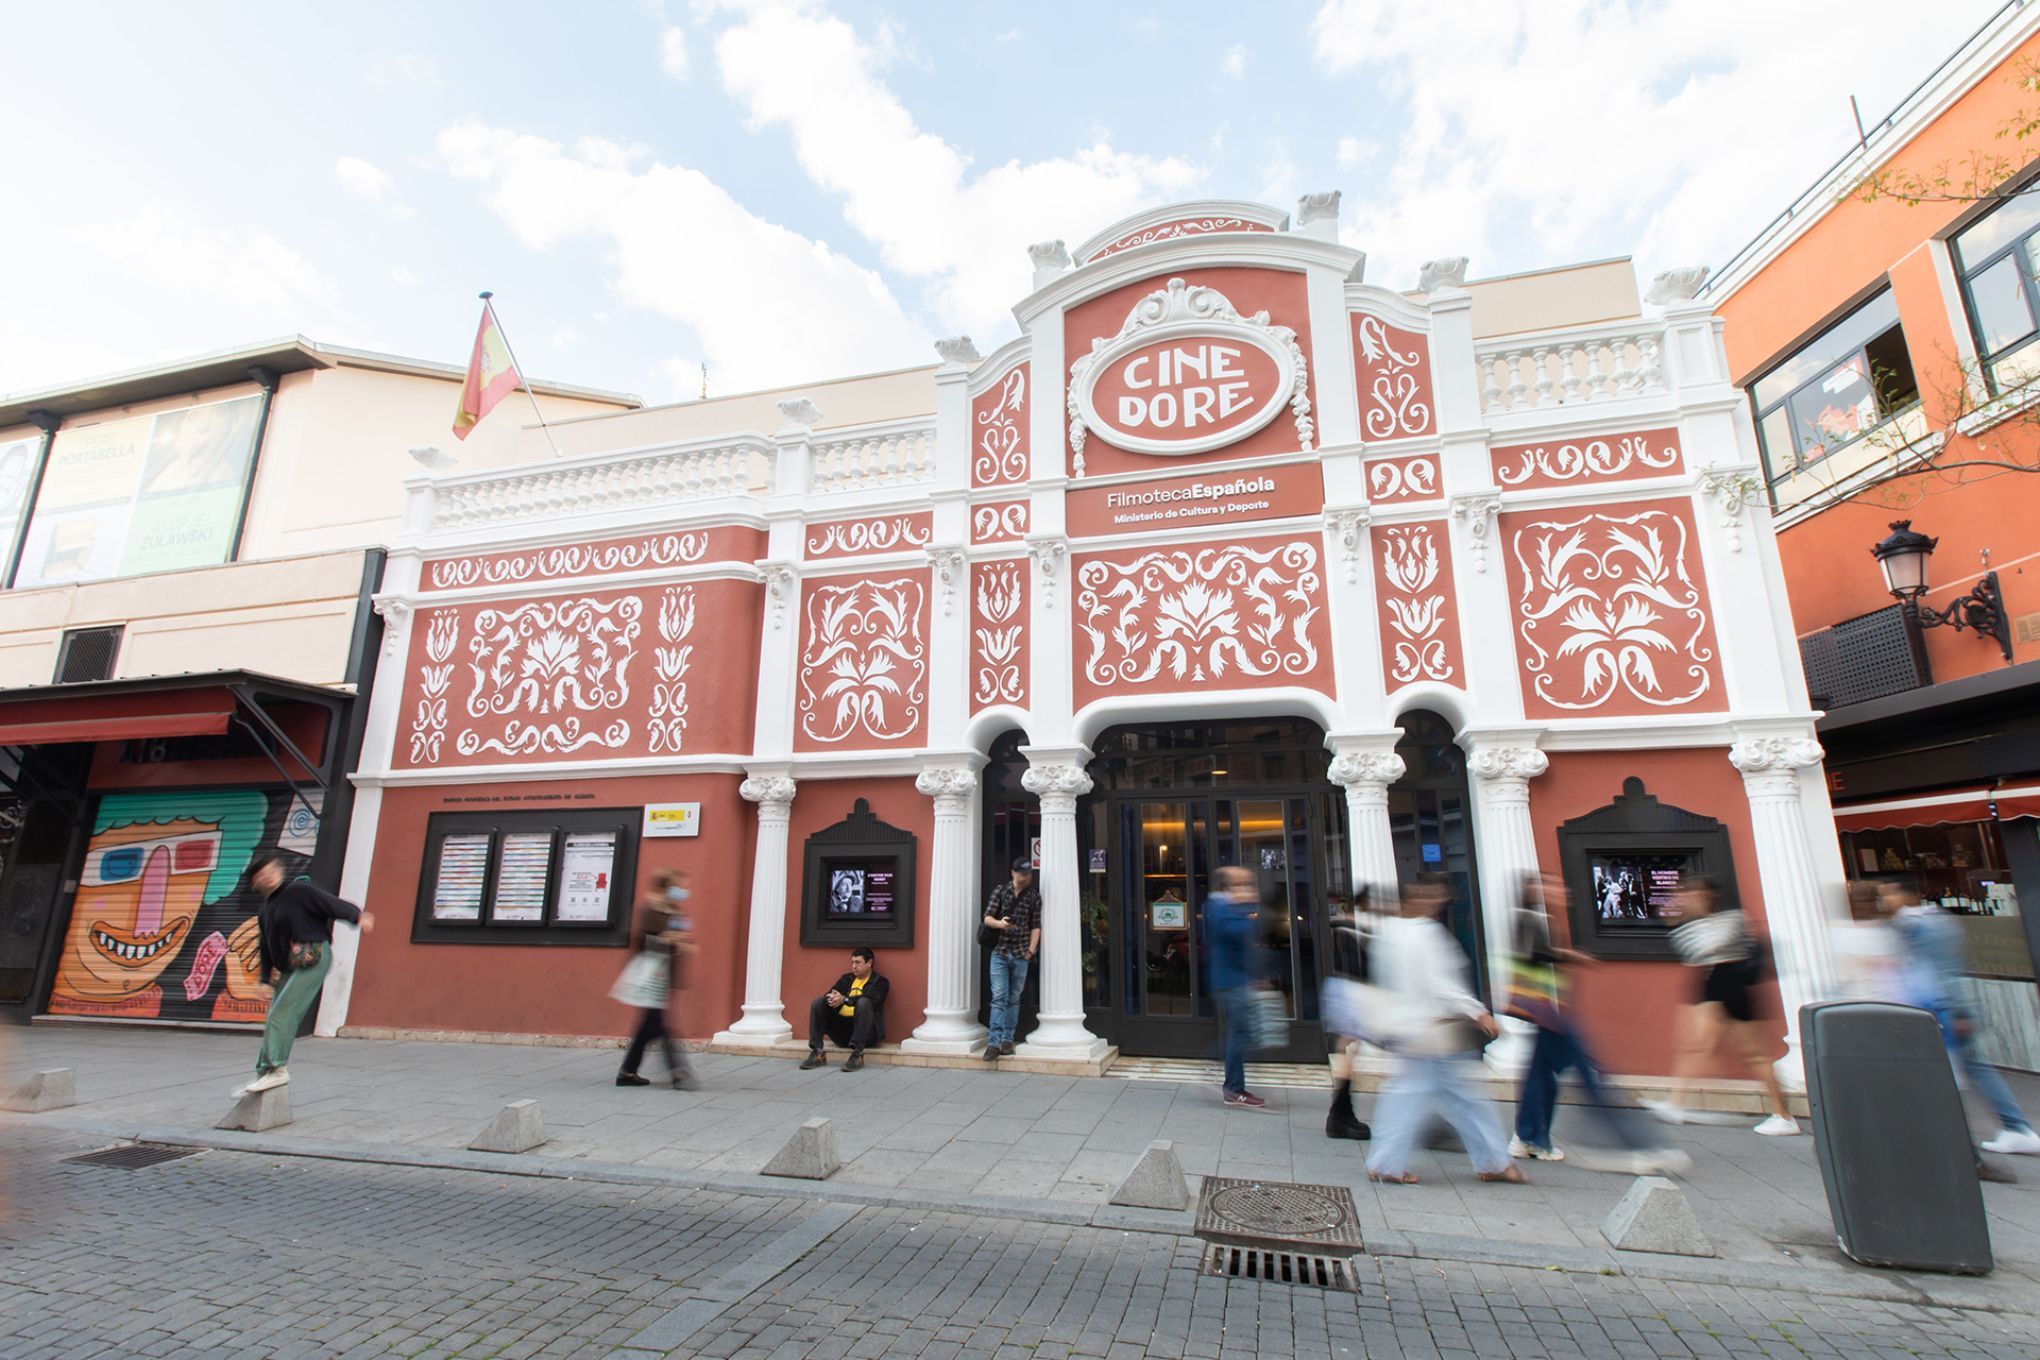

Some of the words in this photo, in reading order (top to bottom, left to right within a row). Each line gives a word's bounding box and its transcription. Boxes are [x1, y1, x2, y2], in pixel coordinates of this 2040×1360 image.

[1123, 345, 1244, 389] CINE
[1119, 382, 1254, 428] DORE
[1107, 476, 1275, 508] FilmotecaEspañola
[1114, 509, 1164, 524] Ministerio
[1165, 508, 1178, 519] de
[1179, 504, 1218, 517] Cultura
[1227, 500, 1269, 514] Deporte
